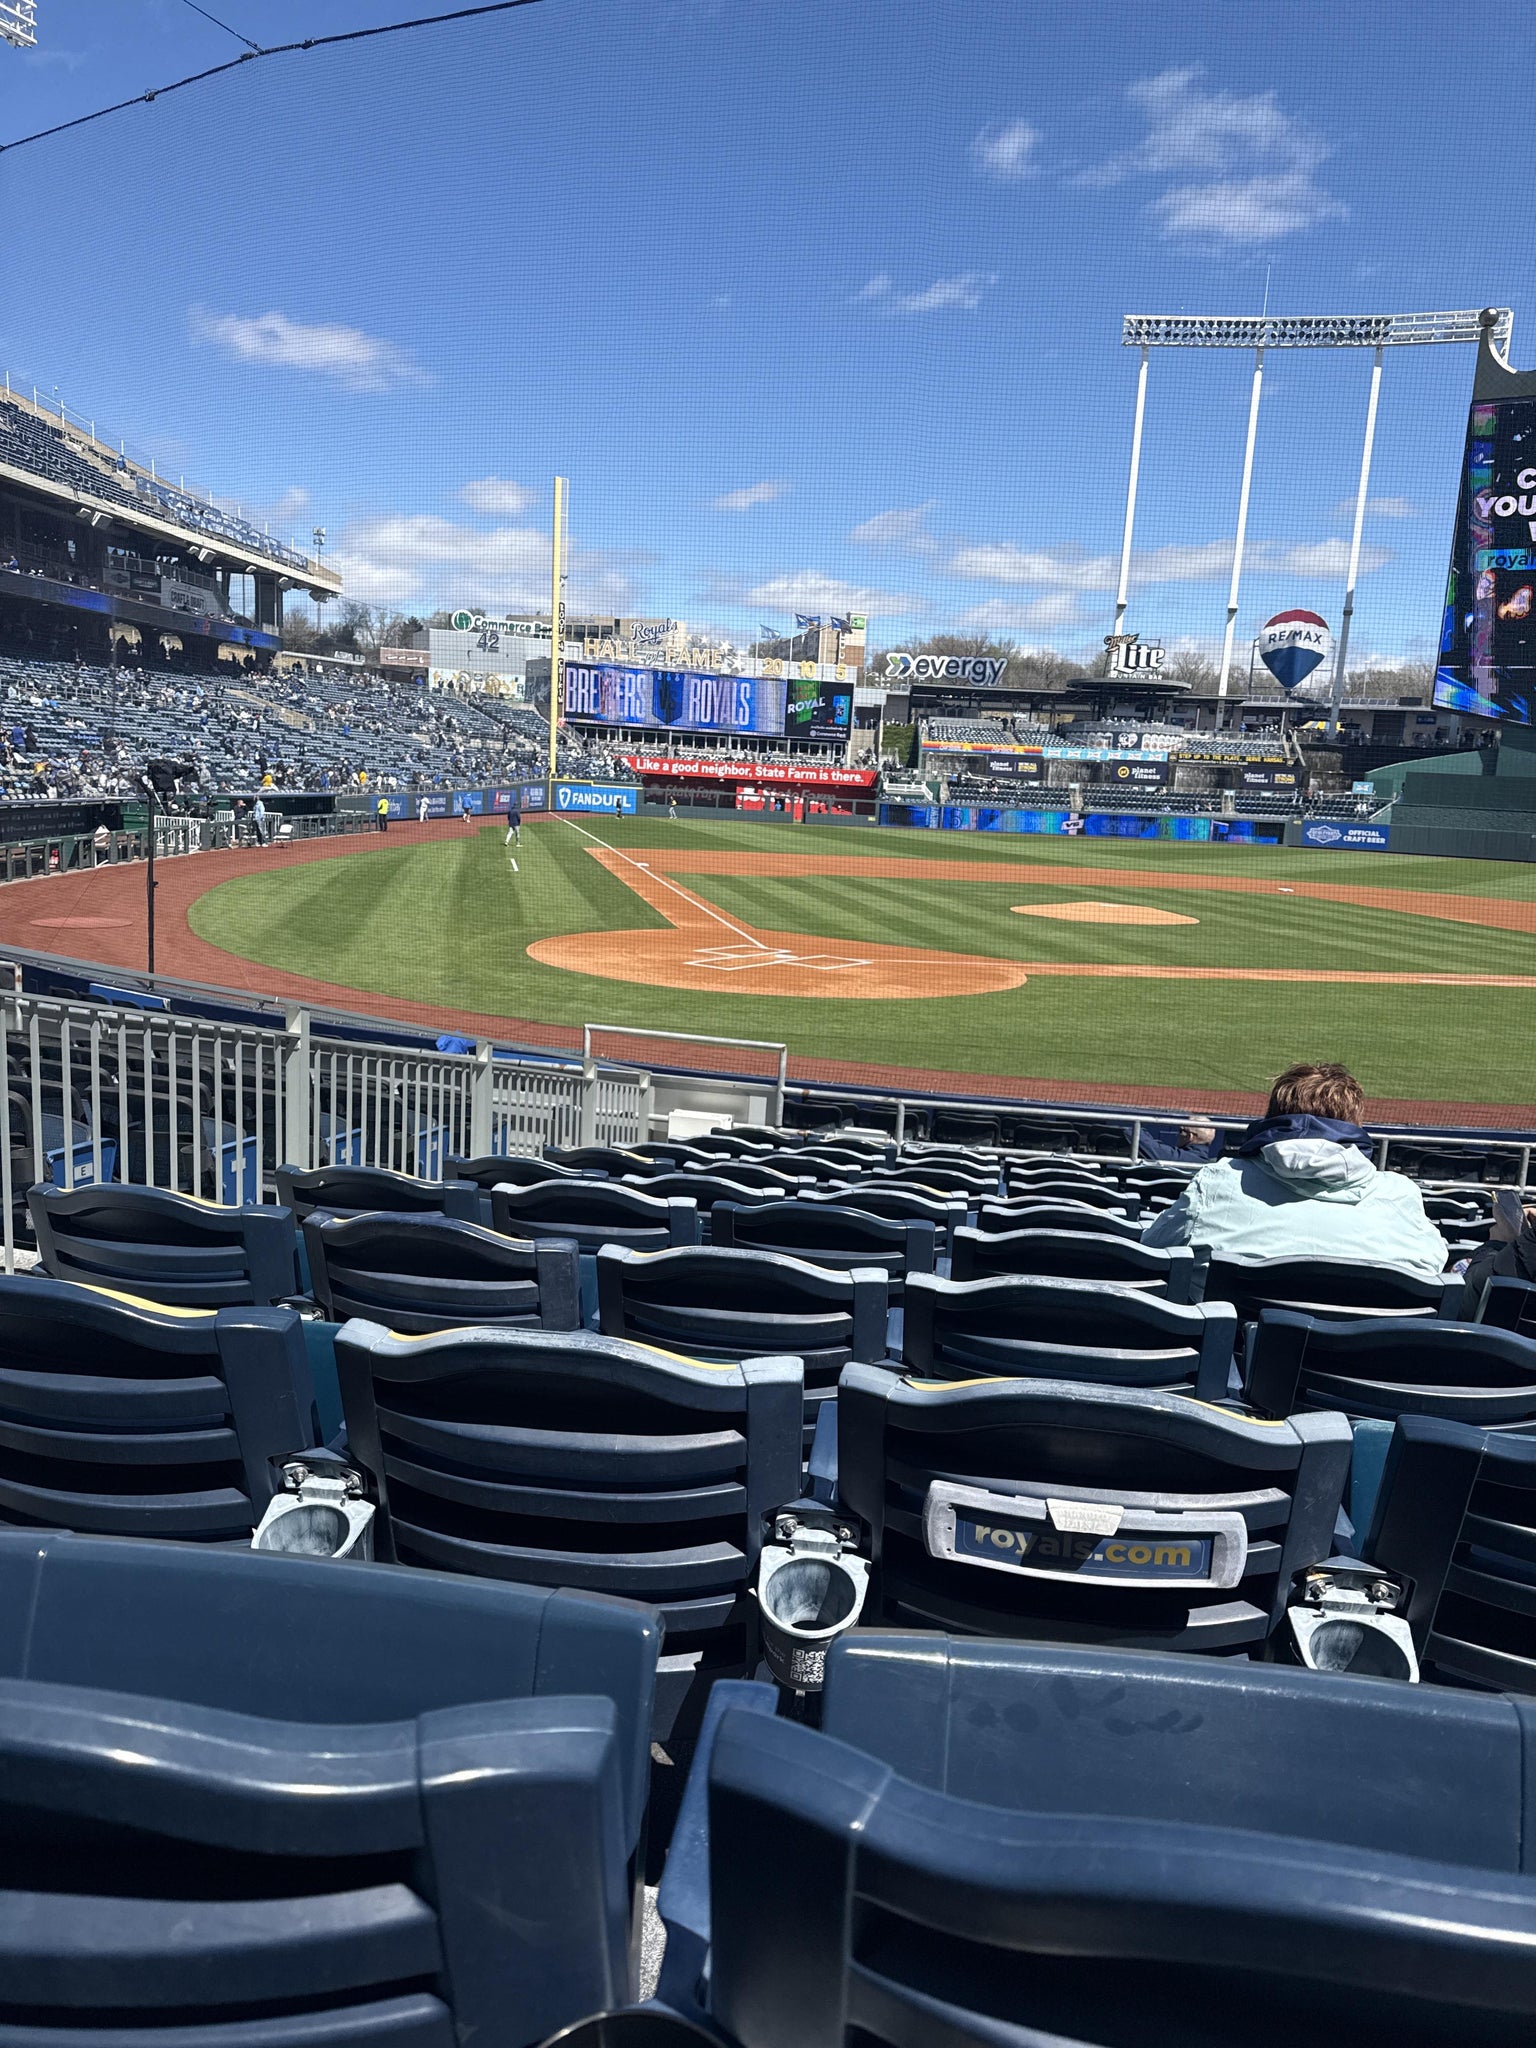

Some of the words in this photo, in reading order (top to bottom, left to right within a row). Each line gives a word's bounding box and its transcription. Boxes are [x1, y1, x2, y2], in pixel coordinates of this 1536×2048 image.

[474, 617, 531, 632] Commerce
[631, 617, 679, 644] Royals
[477, 632, 500, 652] 42
[1268, 629, 1323, 645] RE/MAX
[583, 637, 643, 662] HALL
[665, 646, 725, 668] FAME
[1114, 643, 1165, 674] Lite
[762, 657, 783, 676] 20
[800, 660, 817, 679] 10
[835, 663, 847, 681] 5
[914, 656, 1007, 686] evergy
[565, 667, 646, 718] BREWERS
[688, 678, 751, 726] ROYALS
[787, 696, 826, 714] ROYAL
[636, 758, 660, 771] Like
[662, 763, 670, 771] a
[671, 762, 699, 774] good
[701, 764, 752, 778] neighbor,
[755, 766, 785, 778] State
[787, 768, 817, 780] Farm
[819, 770, 829, 780] is
[831, 772, 864, 783] there.
[1131, 766, 1157, 775] planet
[1134, 772, 1161, 780] fitness
[1348, 829, 1380, 837] OFFICIAL
[80, 1165, 87, 1176] E
[975, 1525, 1191, 1567] royals.com
